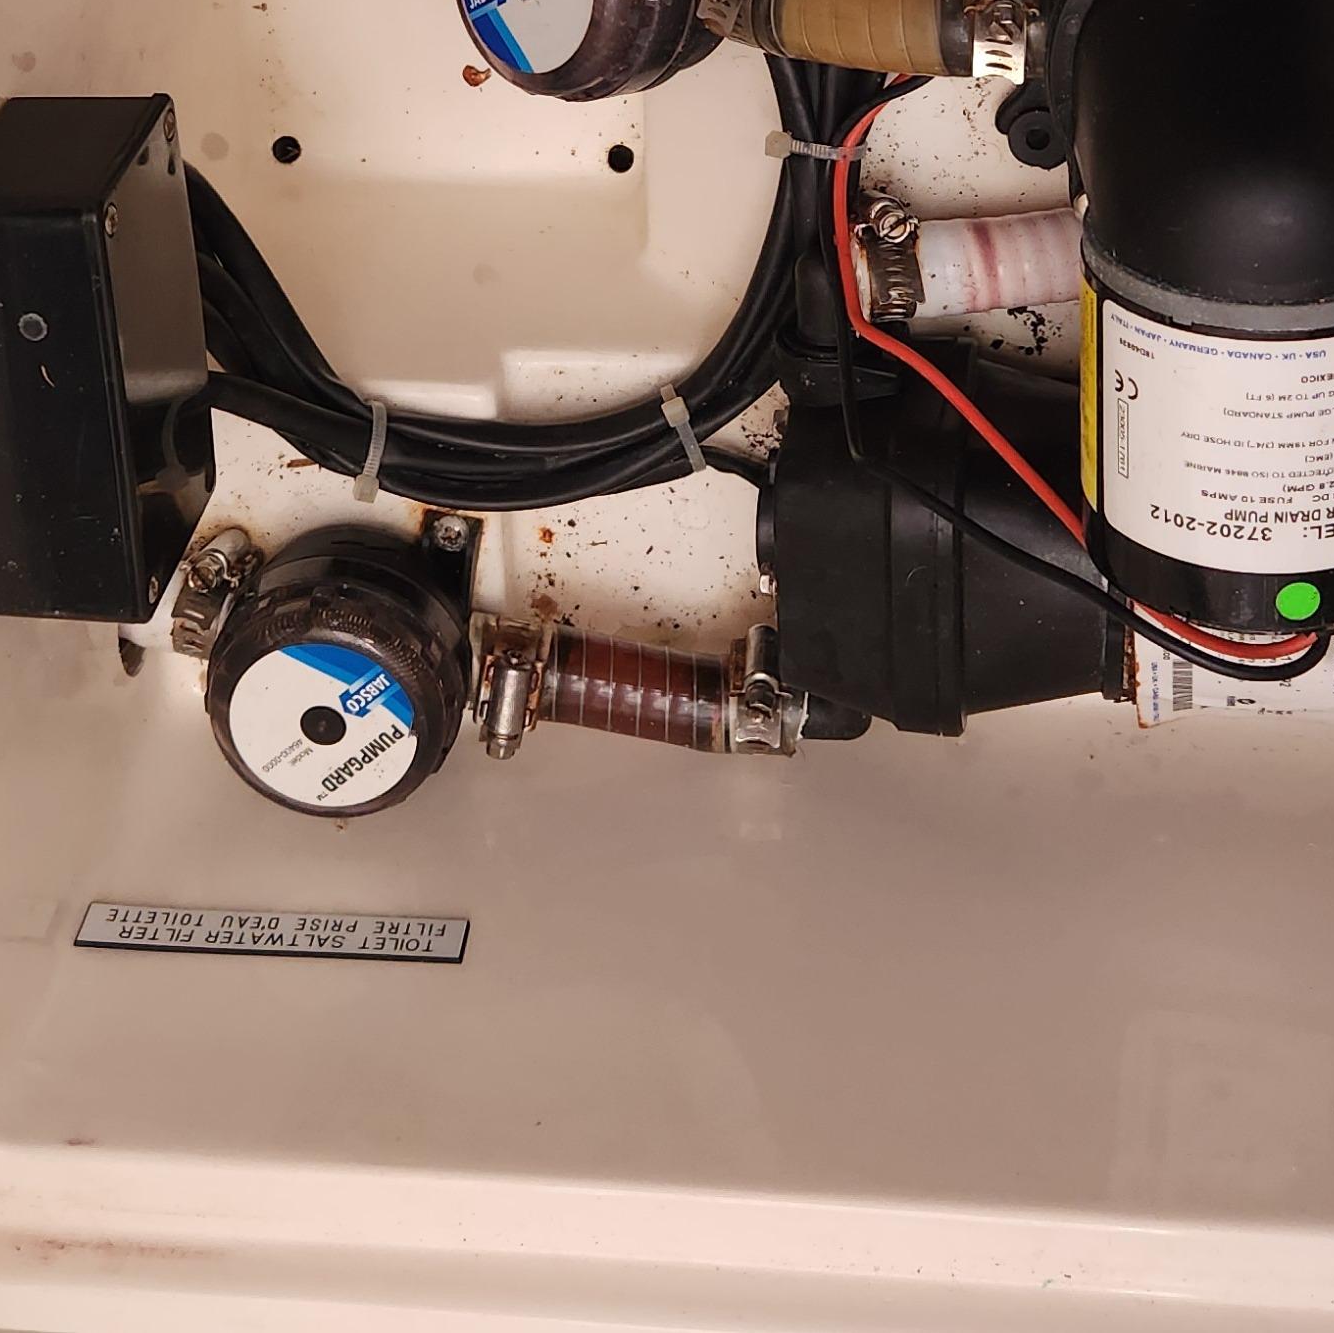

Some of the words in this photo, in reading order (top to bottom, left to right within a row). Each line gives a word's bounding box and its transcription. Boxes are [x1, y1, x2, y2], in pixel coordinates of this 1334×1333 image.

[1110, 313, 1129, 330] ITALY
[1134, 325, 1162, 342] JAPAN
[1169, 338, 1218, 356] GERMANY
[1227, 349, 1272, 361] CANADA
[1281, 352, 1296, 361] UK
[1305, 349, 1327, 360] USA
[1278, 394, 1293, 402] 2M
[1311, 392, 1326, 400] UP
[1223, 407, 1283, 419] STANDARD)
[1285, 410, 1315, 418] PUMP
[1180, 431, 1200, 441] DRY
[1203, 435, 1231, 446] HOSE
[1308, 439, 1330, 448] FOR
[1304, 451, 1334, 463] (EMC)
[1200, 489, 1237, 502] AMPS
[1241, 495, 1255, 504] 10
[1258, 496, 1293, 504] FUSE
[1311, 493, 1329, 503] DC
[1149, 503, 1272, 542] 37202-2012
[1224, 508, 1268, 524] PUMP
[1274, 508, 1321, 524] DRAIN
[345, 673, 391, 712] JABSCO
[321, 724, 405, 793] PUMPGARD
[105, 907, 204, 927] TOILETTE
[220, 914, 280, 930] D'EAU
[295, 916, 359, 932] PRISE
[118, 924, 195, 943] FILTER
[374, 920, 447, 937] FILTRE
[203, 929, 346, 949] SALTWATER
[355, 935, 434, 953] TOILET
